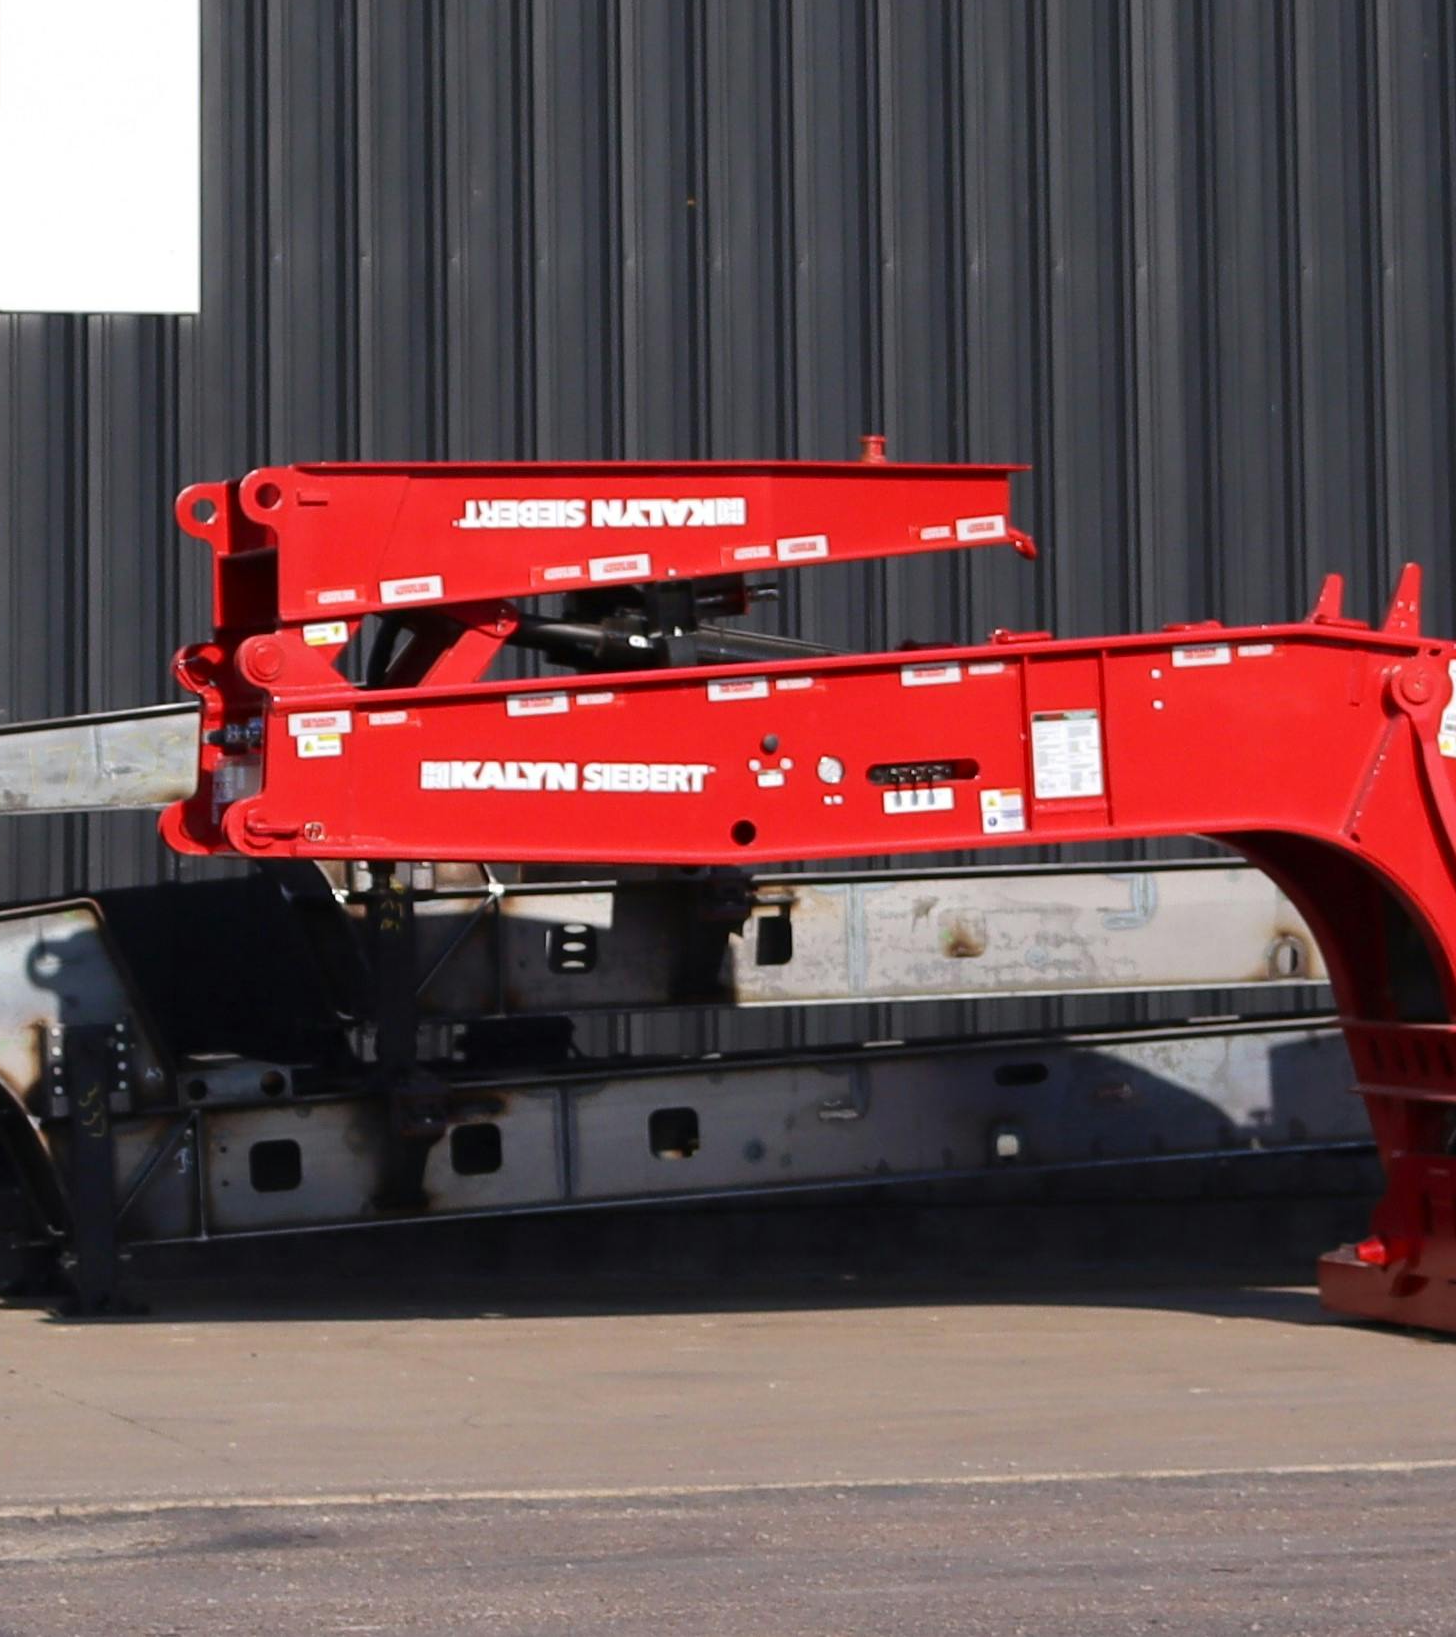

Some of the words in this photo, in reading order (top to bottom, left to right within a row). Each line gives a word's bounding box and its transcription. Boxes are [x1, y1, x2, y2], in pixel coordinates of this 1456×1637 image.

[459, 499, 586, 528] SIEBERT
[592, 499, 715, 528] KALYN
[450, 761, 578, 791] KALYN
[582, 763, 710, 793] SIEBERT
